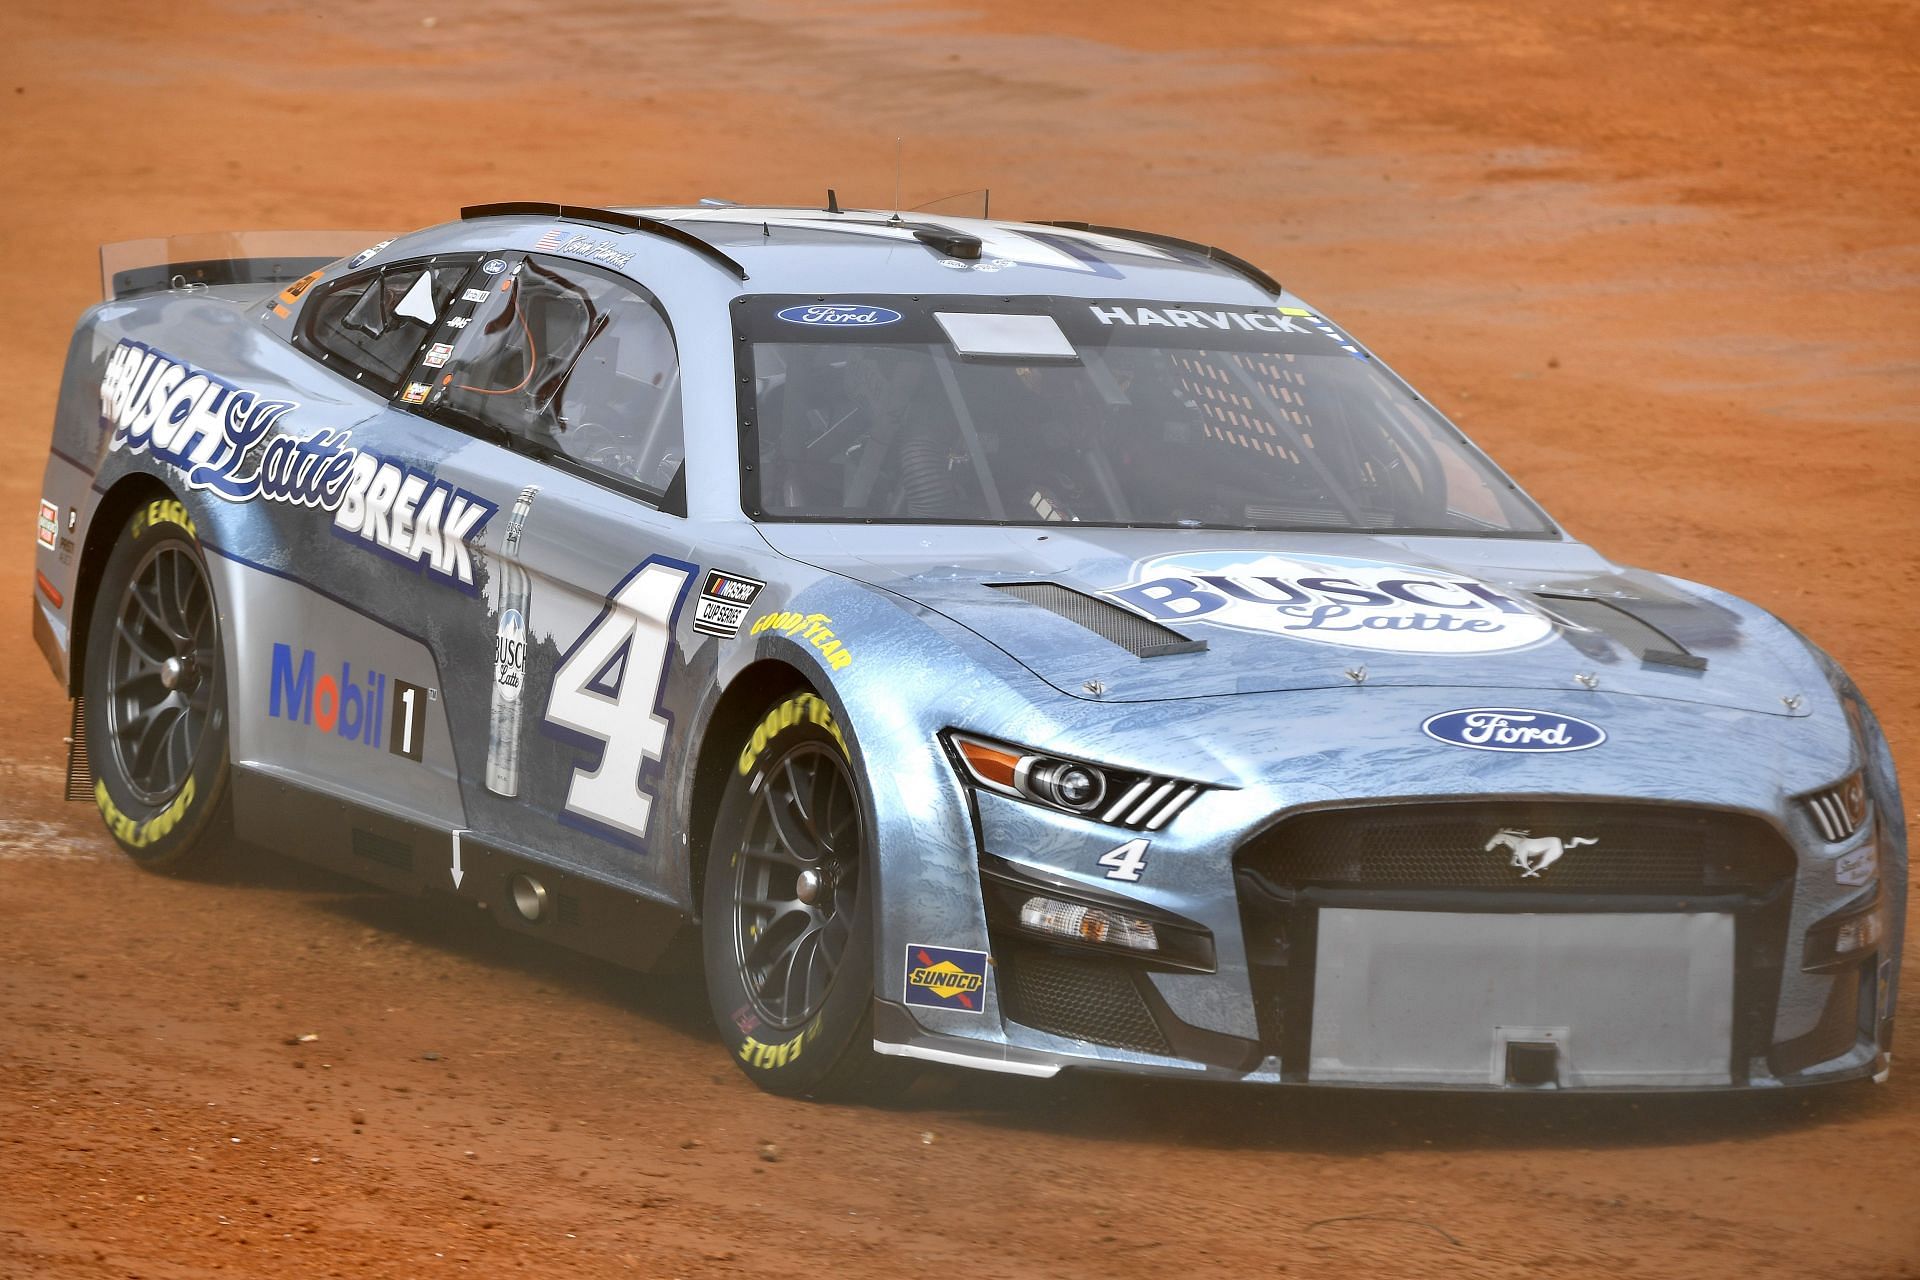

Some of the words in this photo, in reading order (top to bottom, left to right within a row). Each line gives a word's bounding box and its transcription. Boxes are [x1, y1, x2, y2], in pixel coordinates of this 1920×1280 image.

[802, 306, 878, 323] Ford
[1089, 306, 1313, 334] HARVICK
[188, 389, 358, 511] Latte
[334, 452, 489, 586] BREAK
[720, 580, 756, 602] NASCAR
[703, 603, 721, 620] CUP
[717, 606, 742, 625] SERIES
[1276, 603, 1506, 633] Latte
[750, 610, 852, 671] GOODYEAR
[498, 664, 520, 688] Latte
[269, 642, 386, 749] Mobil
[402, 688, 416, 754] 1
[542, 558, 695, 846] 4
[1461, 712, 1573, 745] Ford
[1097, 837, 1149, 883] 4
[911, 969, 981, 990] SUNOCO
